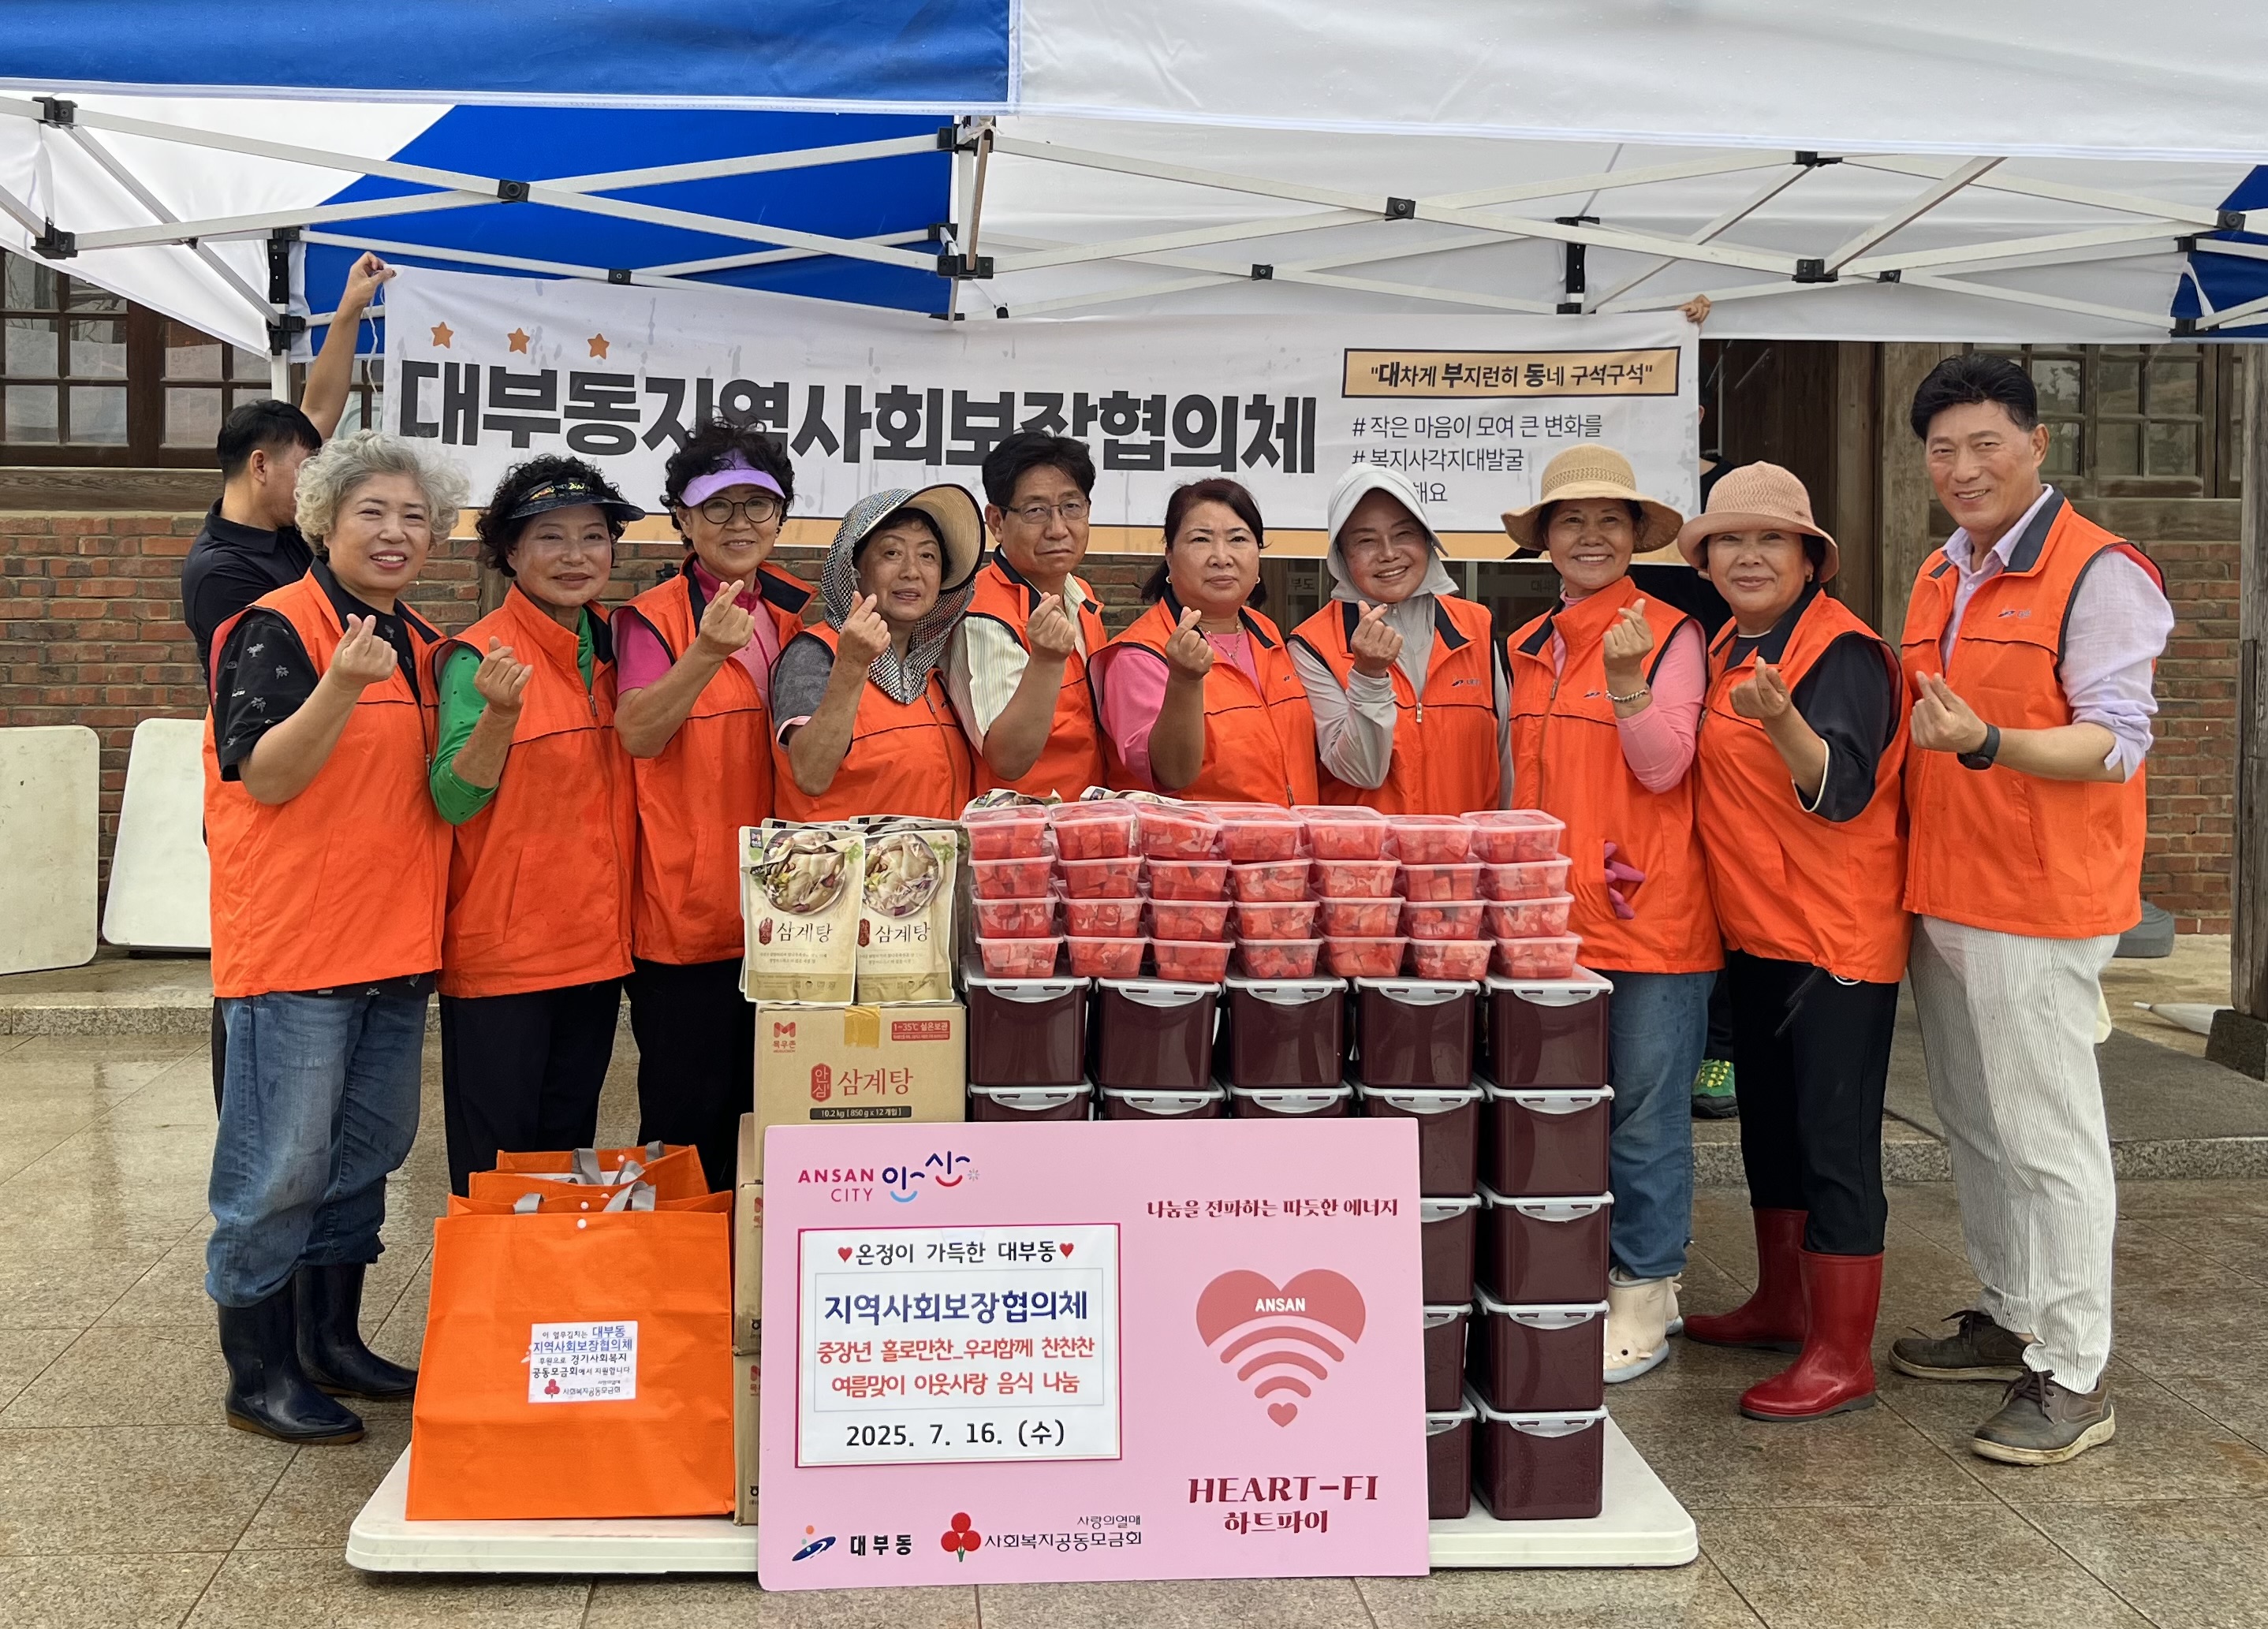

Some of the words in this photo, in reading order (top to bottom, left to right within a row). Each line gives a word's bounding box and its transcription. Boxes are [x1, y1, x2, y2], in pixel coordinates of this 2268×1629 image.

[1371, 362, 1437, 388] "대차게
[1441, 363, 1519, 388] 부지런히
[1524, 363, 1565, 387] 동네
[1570, 364, 1654, 386] 구석구석"
[400, 359, 1316, 473] 대부동지역사회보장협의체
[1370, 415, 1409, 438] 작은
[1414, 415, 1472, 438] 마음이
[1475, 415, 1515, 438] 모여
[1519, 415, 1539, 437] 큰
[1544, 414, 1602, 438] 변화를
[1371, 449, 1524, 472] 복지사각지대발굴
[776, 921, 834, 943] 삼계탕
[875, 921, 931, 943] 삼계탕
[837, 1068, 913, 1096] 삼계탕
[798, 1168, 875, 1184] ANSAN
[830, 1188, 873, 1202] CITY
[1146, 1199, 1200, 1218] 나눔을
[1205, 1198, 1278, 1217] 전파하는
[1283, 1198, 1339, 1217] 따듯한
[1343, 1198, 1398, 1217] 에너지
[856, 1243, 914, 1266] 온정이
[927, 1241, 986, 1263] 가득한
[998, 1240, 1056, 1263] 대부동
[824, 1289, 1087, 1325] 지역사회보장협의체
[1255, 1297, 1306, 1312] ANSAN
[592, 1325, 625, 1339] 대부동
[533, 1338, 632, 1353] 지역사회보장협의체
[817, 1340, 871, 1364] 중장년
[1041, 1336, 1095, 1359] 찬찬찬
[571, 1353, 627, 1365] 경기사회복지
[532, 1366, 592, 1378] 공동모금회에서
[595, 1367, 630, 1376] 지원합니다
[831, 1374, 905, 1398] 여름맞이
[914, 1373, 988, 1396] 이웃사랑
[997, 1371, 1033, 1395] 음식
[1043, 1370, 1080, 1394] 나눔
[846, 1425, 915, 1448] 2025.
[929, 1423, 950, 1446] 7.
[966, 1422, 1003, 1445] 16.
[1017, 1418, 1065, 1448] (수)
[1188, 1475, 1378, 1504] HEART-FI
[1076, 1515, 1141, 1529] 사랑의열매
[1223, 1510, 1328, 1534] 하트파이
[850, 1534, 912, 1556] 대부동
[984, 1530, 1142, 1553] 사회복지공동모금회
